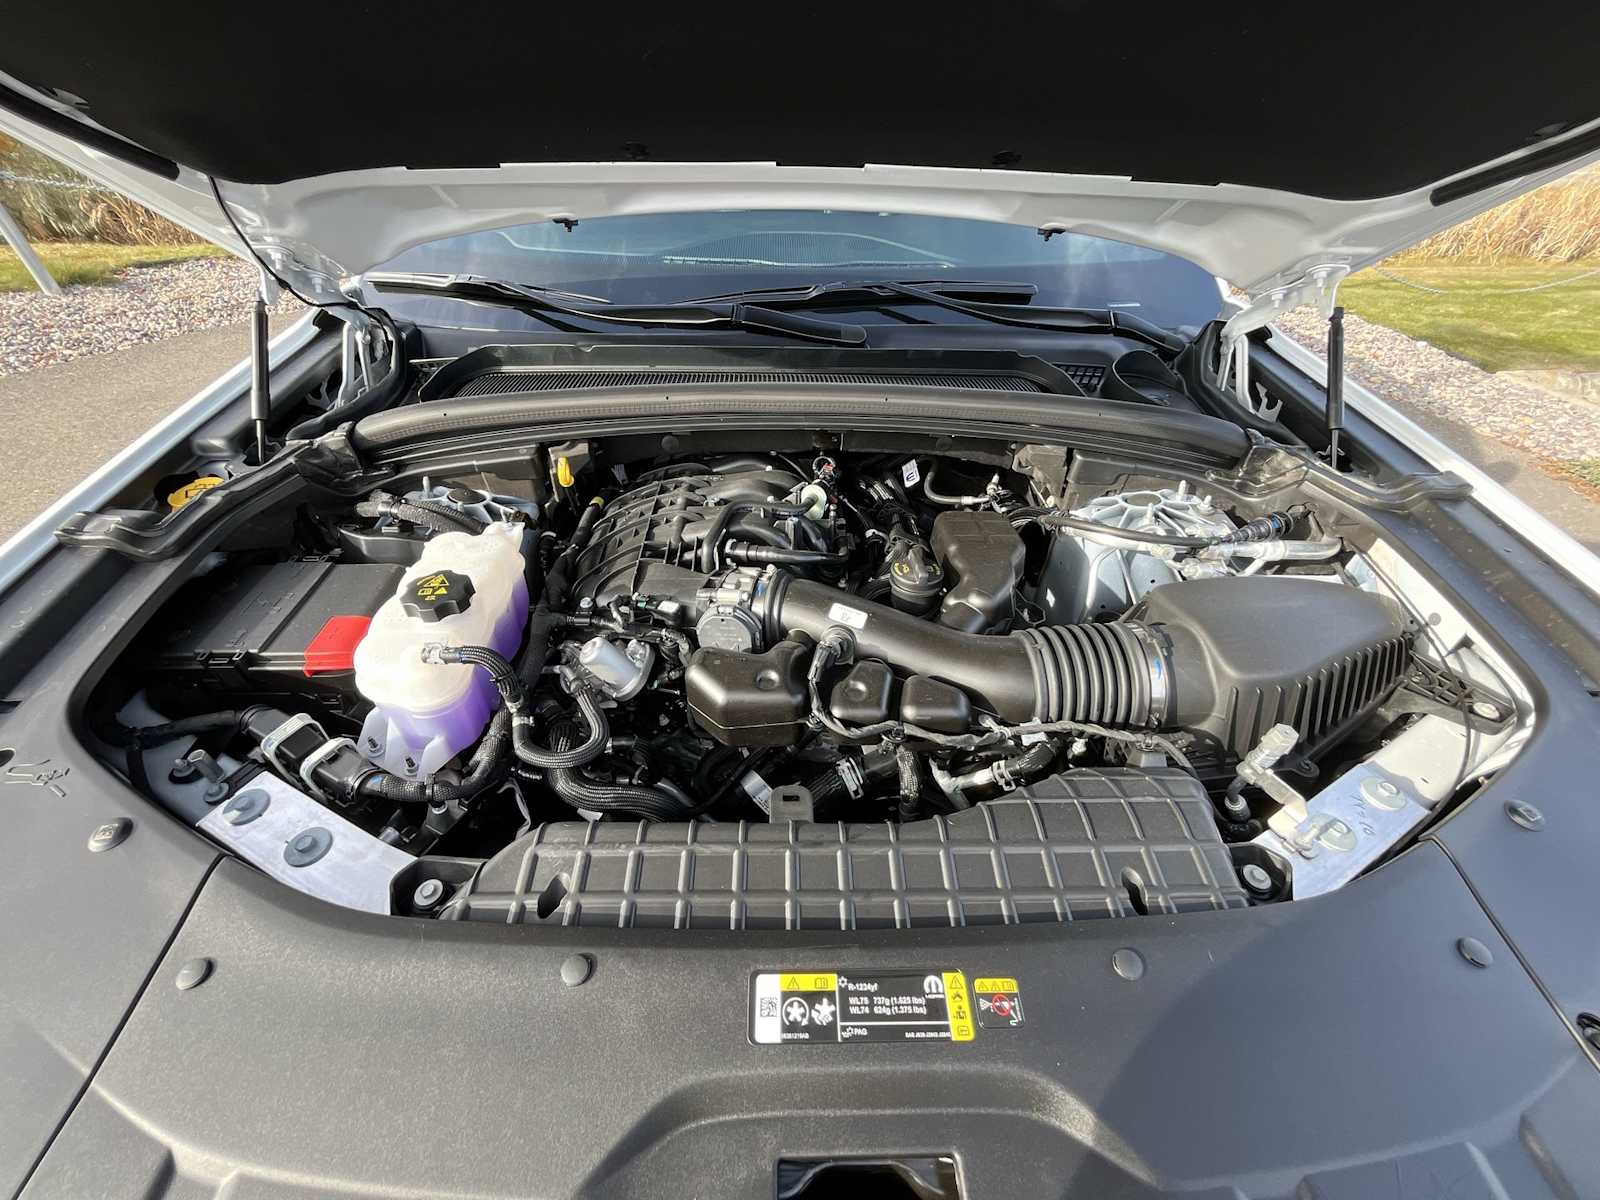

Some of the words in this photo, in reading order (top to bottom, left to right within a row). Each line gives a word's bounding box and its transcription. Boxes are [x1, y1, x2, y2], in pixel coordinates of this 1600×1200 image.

[848, 996, 869, 1005] WL75
[873, 996, 890, 1006] 737g
[849, 1006, 870, 1015] WL74
